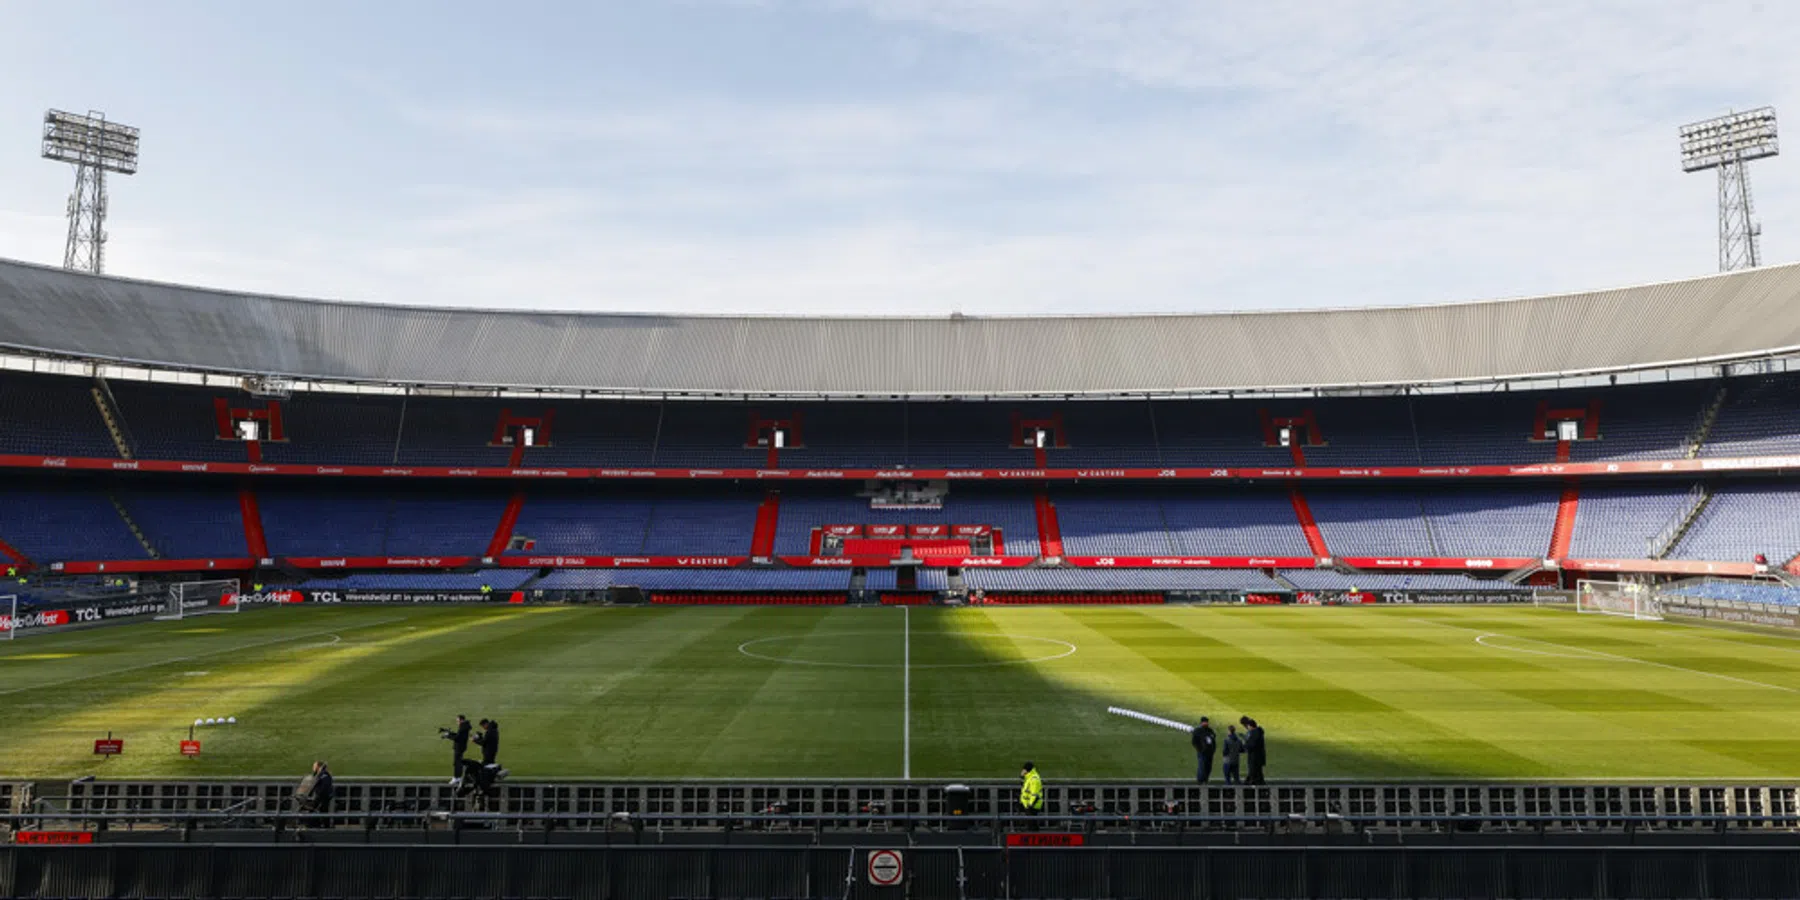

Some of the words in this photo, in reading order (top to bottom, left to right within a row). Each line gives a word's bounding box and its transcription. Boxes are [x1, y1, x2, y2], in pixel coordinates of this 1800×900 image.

[311, 592, 341, 602] TCL
[1383, 592, 1413, 602] TCL
[76, 608, 101, 621] TCL
